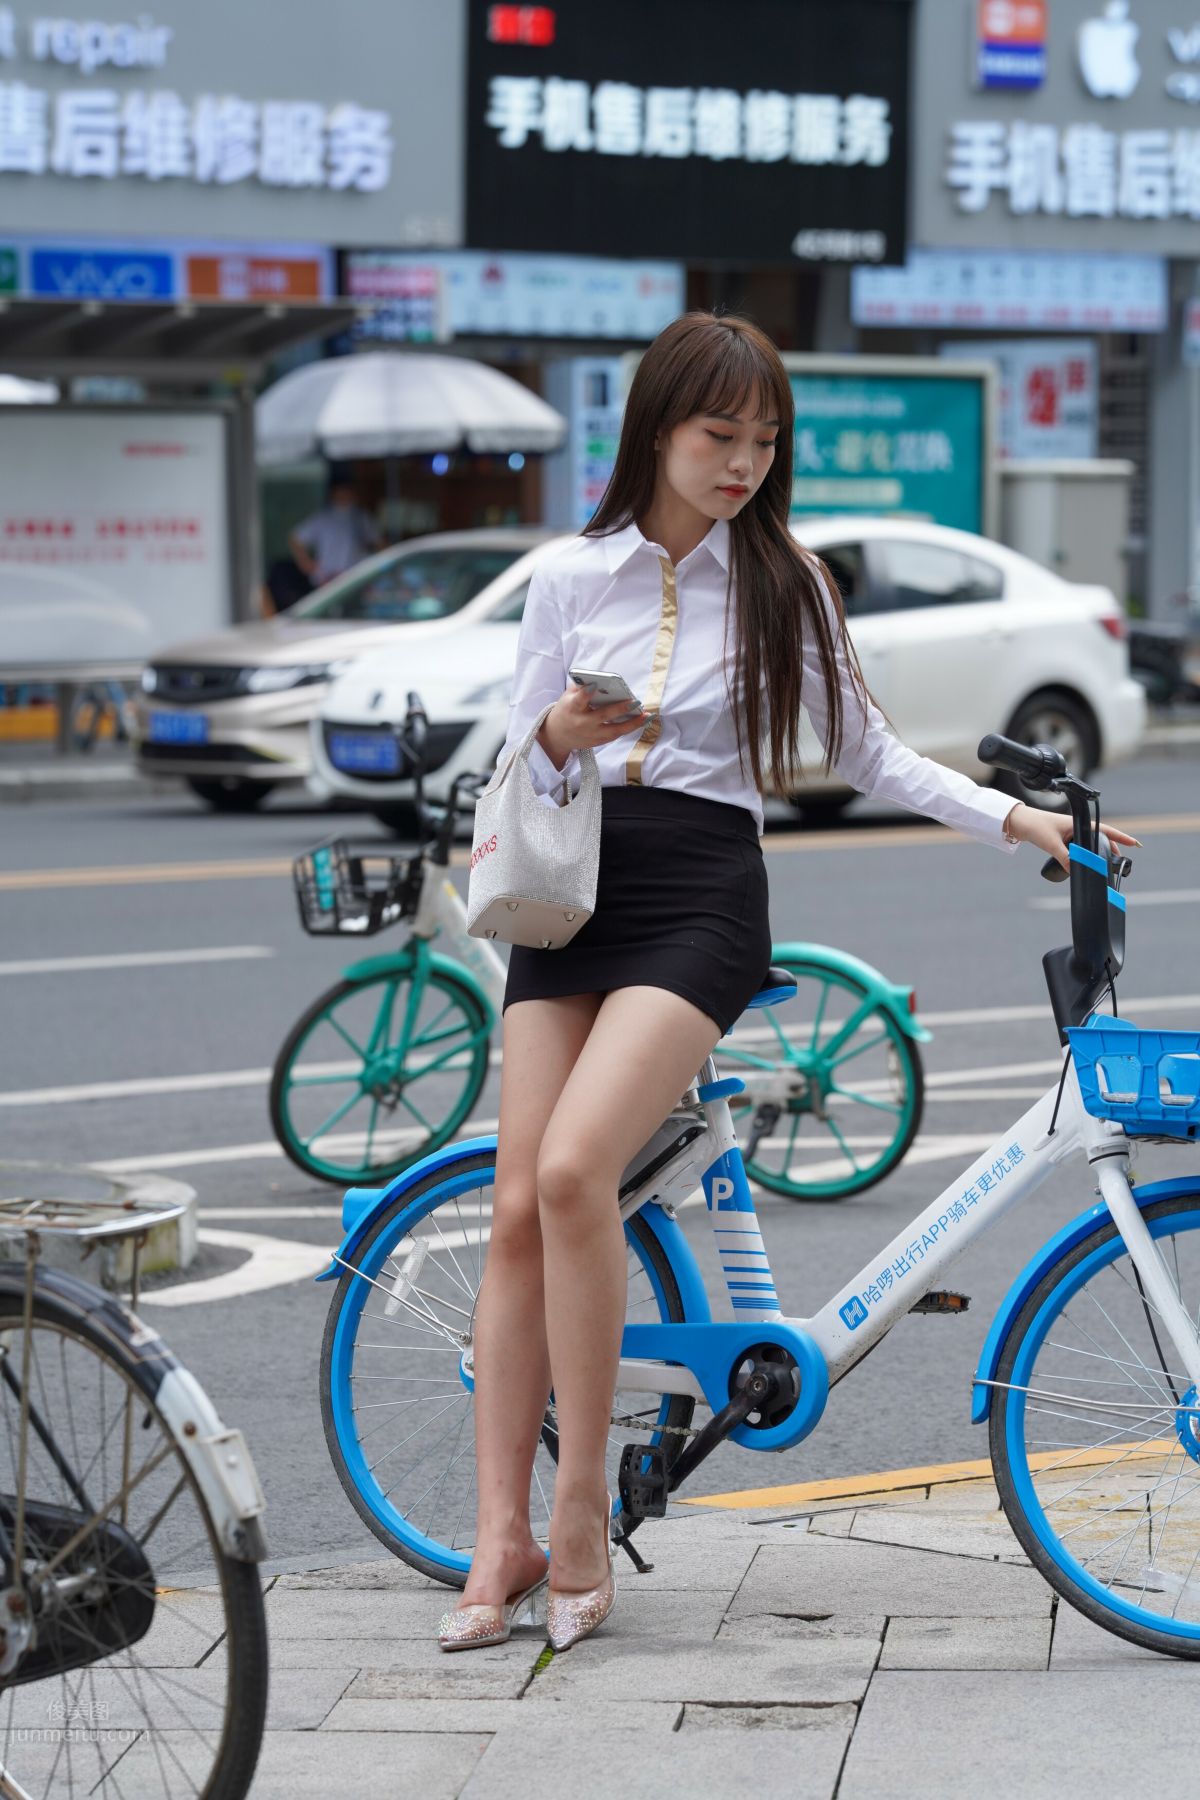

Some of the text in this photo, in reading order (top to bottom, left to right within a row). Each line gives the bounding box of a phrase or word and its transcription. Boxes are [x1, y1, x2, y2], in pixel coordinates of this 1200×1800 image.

[32, 13, 173, 76] repair
[487, 75, 891, 166] 手机售后维修服务
[51, 258, 156, 297] vivo
[711, 1177, 735, 1211] P
[862, 1142, 1026, 1306] 哈啰出行APP骑车更优惠
